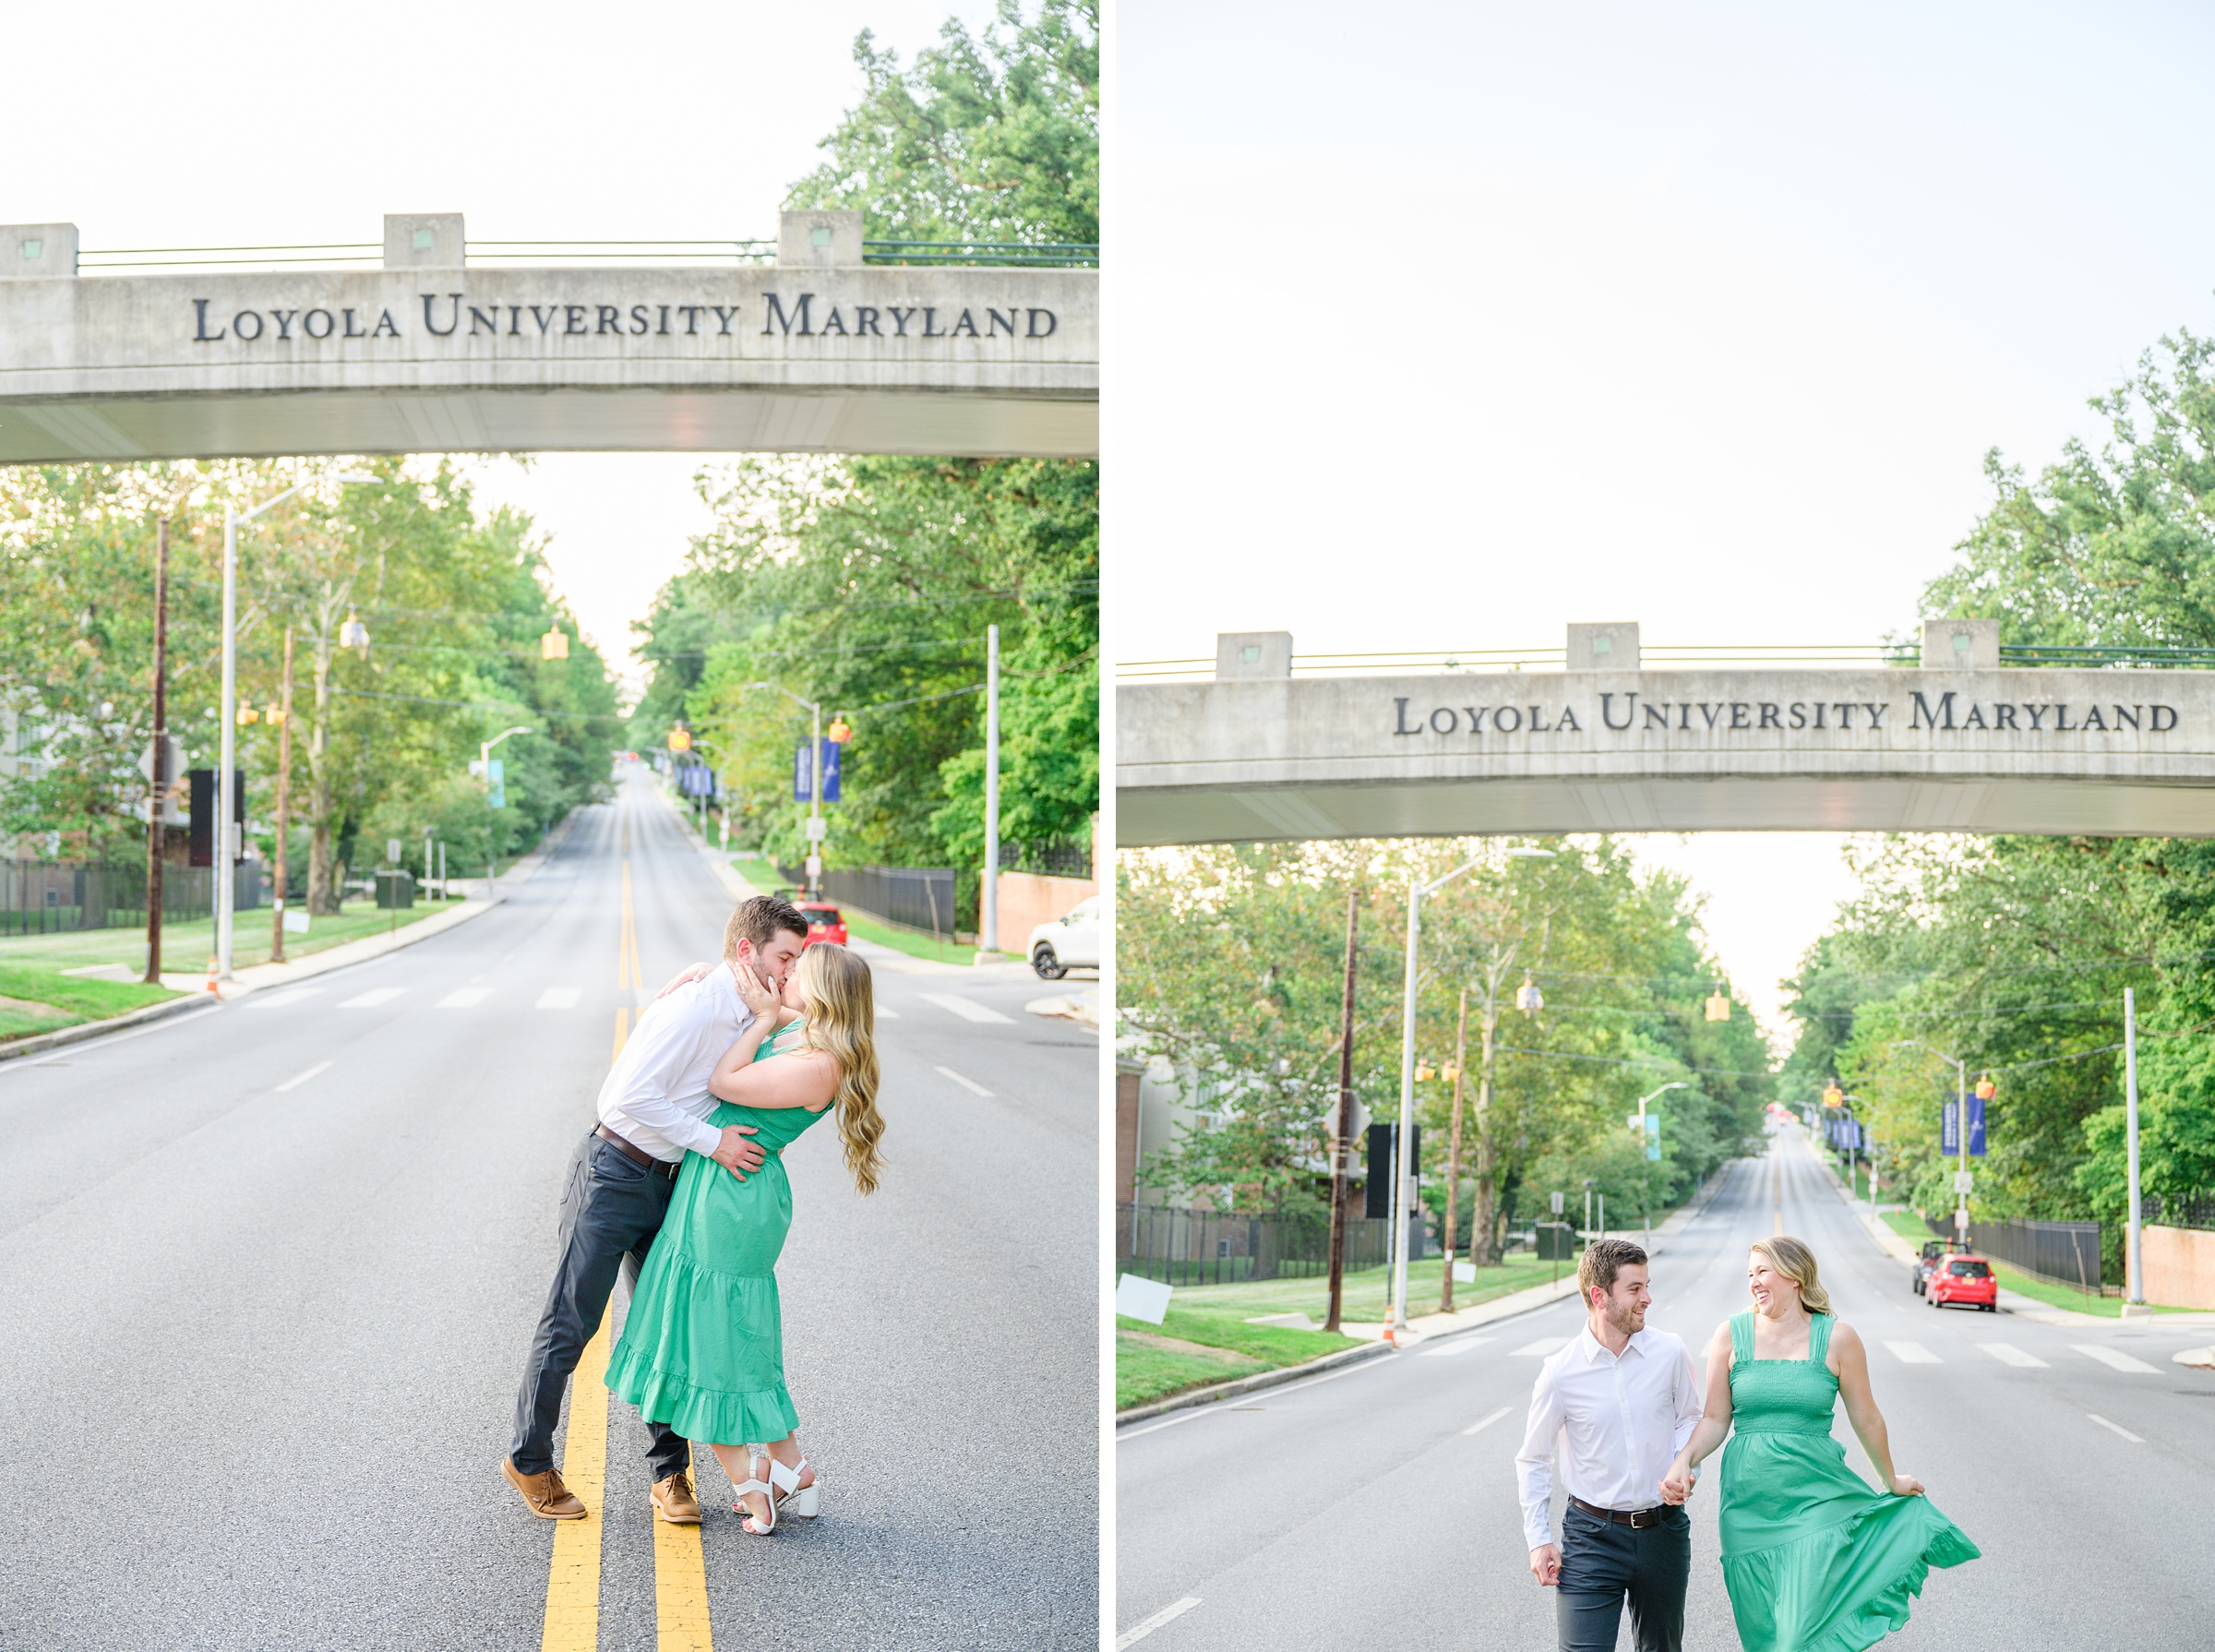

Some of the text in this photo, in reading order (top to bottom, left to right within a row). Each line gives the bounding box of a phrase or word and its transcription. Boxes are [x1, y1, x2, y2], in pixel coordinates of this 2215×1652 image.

[192, 293, 1058, 341] LOYOLA UNIVERSITY MARYLAND
[1393, 691, 2178, 735] LOYOLA UNIVERSITY MARYLAND
